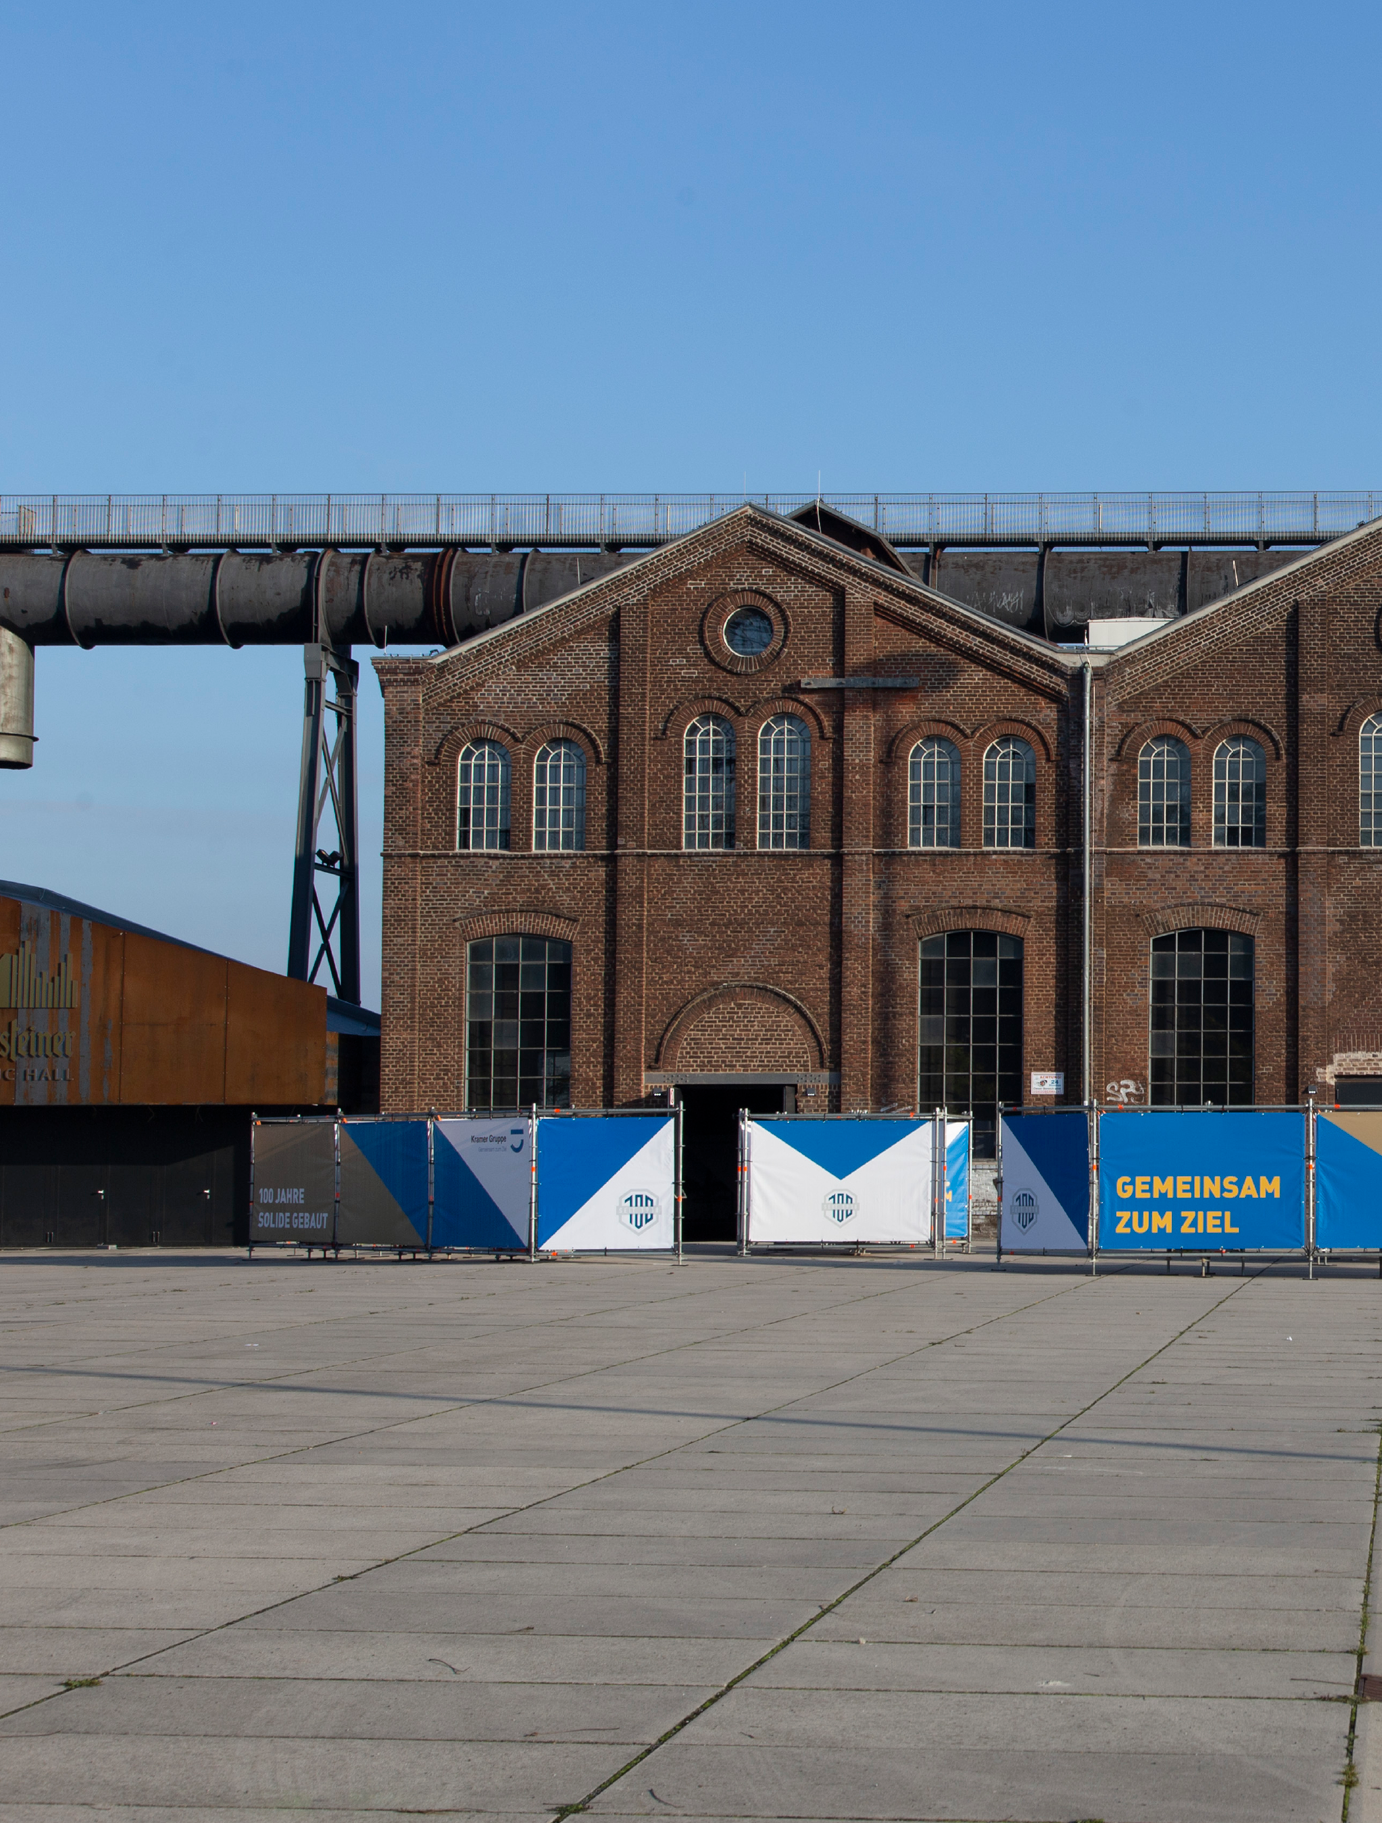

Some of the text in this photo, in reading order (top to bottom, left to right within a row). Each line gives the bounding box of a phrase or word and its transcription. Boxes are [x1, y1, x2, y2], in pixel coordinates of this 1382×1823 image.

[25, 1068, 74, 1081] HALL
[471, 1134, 507, 1144] Kramer Gruppe
[1116, 1176, 1281, 1198] GEMEINSAM
[258, 1188, 305, 1204] 100 JAHRE
[258, 1212, 329, 1229] SOLIDE GEBAUT
[1115, 1211, 1240, 1233] ZUM ZIEL
